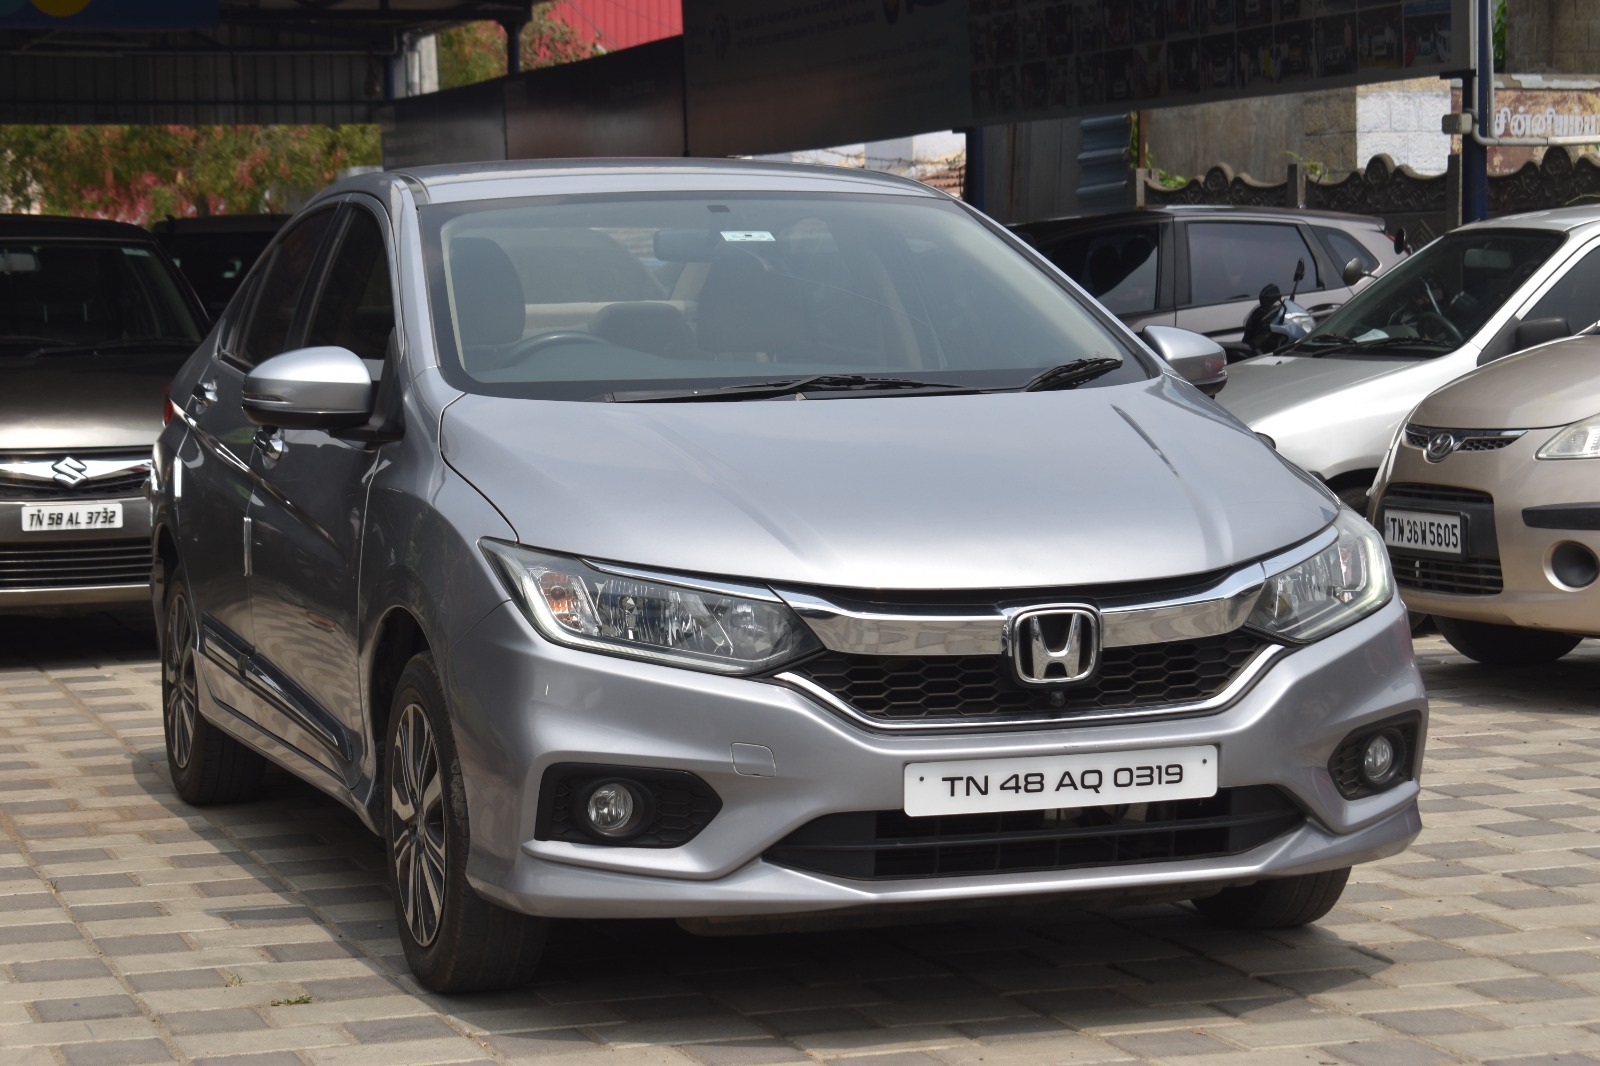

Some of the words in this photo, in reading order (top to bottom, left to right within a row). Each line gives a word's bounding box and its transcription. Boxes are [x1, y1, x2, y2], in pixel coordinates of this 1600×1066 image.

[29, 513, 44, 527] TN
[47, 512, 63, 526] 58
[66, 511, 81, 526] AL
[85, 510, 116, 525] 3732
[941, 775, 989, 797] TN
[999, 772, 1045, 794] 48
[1055, 769, 1103, 794] AQ
[1113, 763, 1184, 788] 0319
